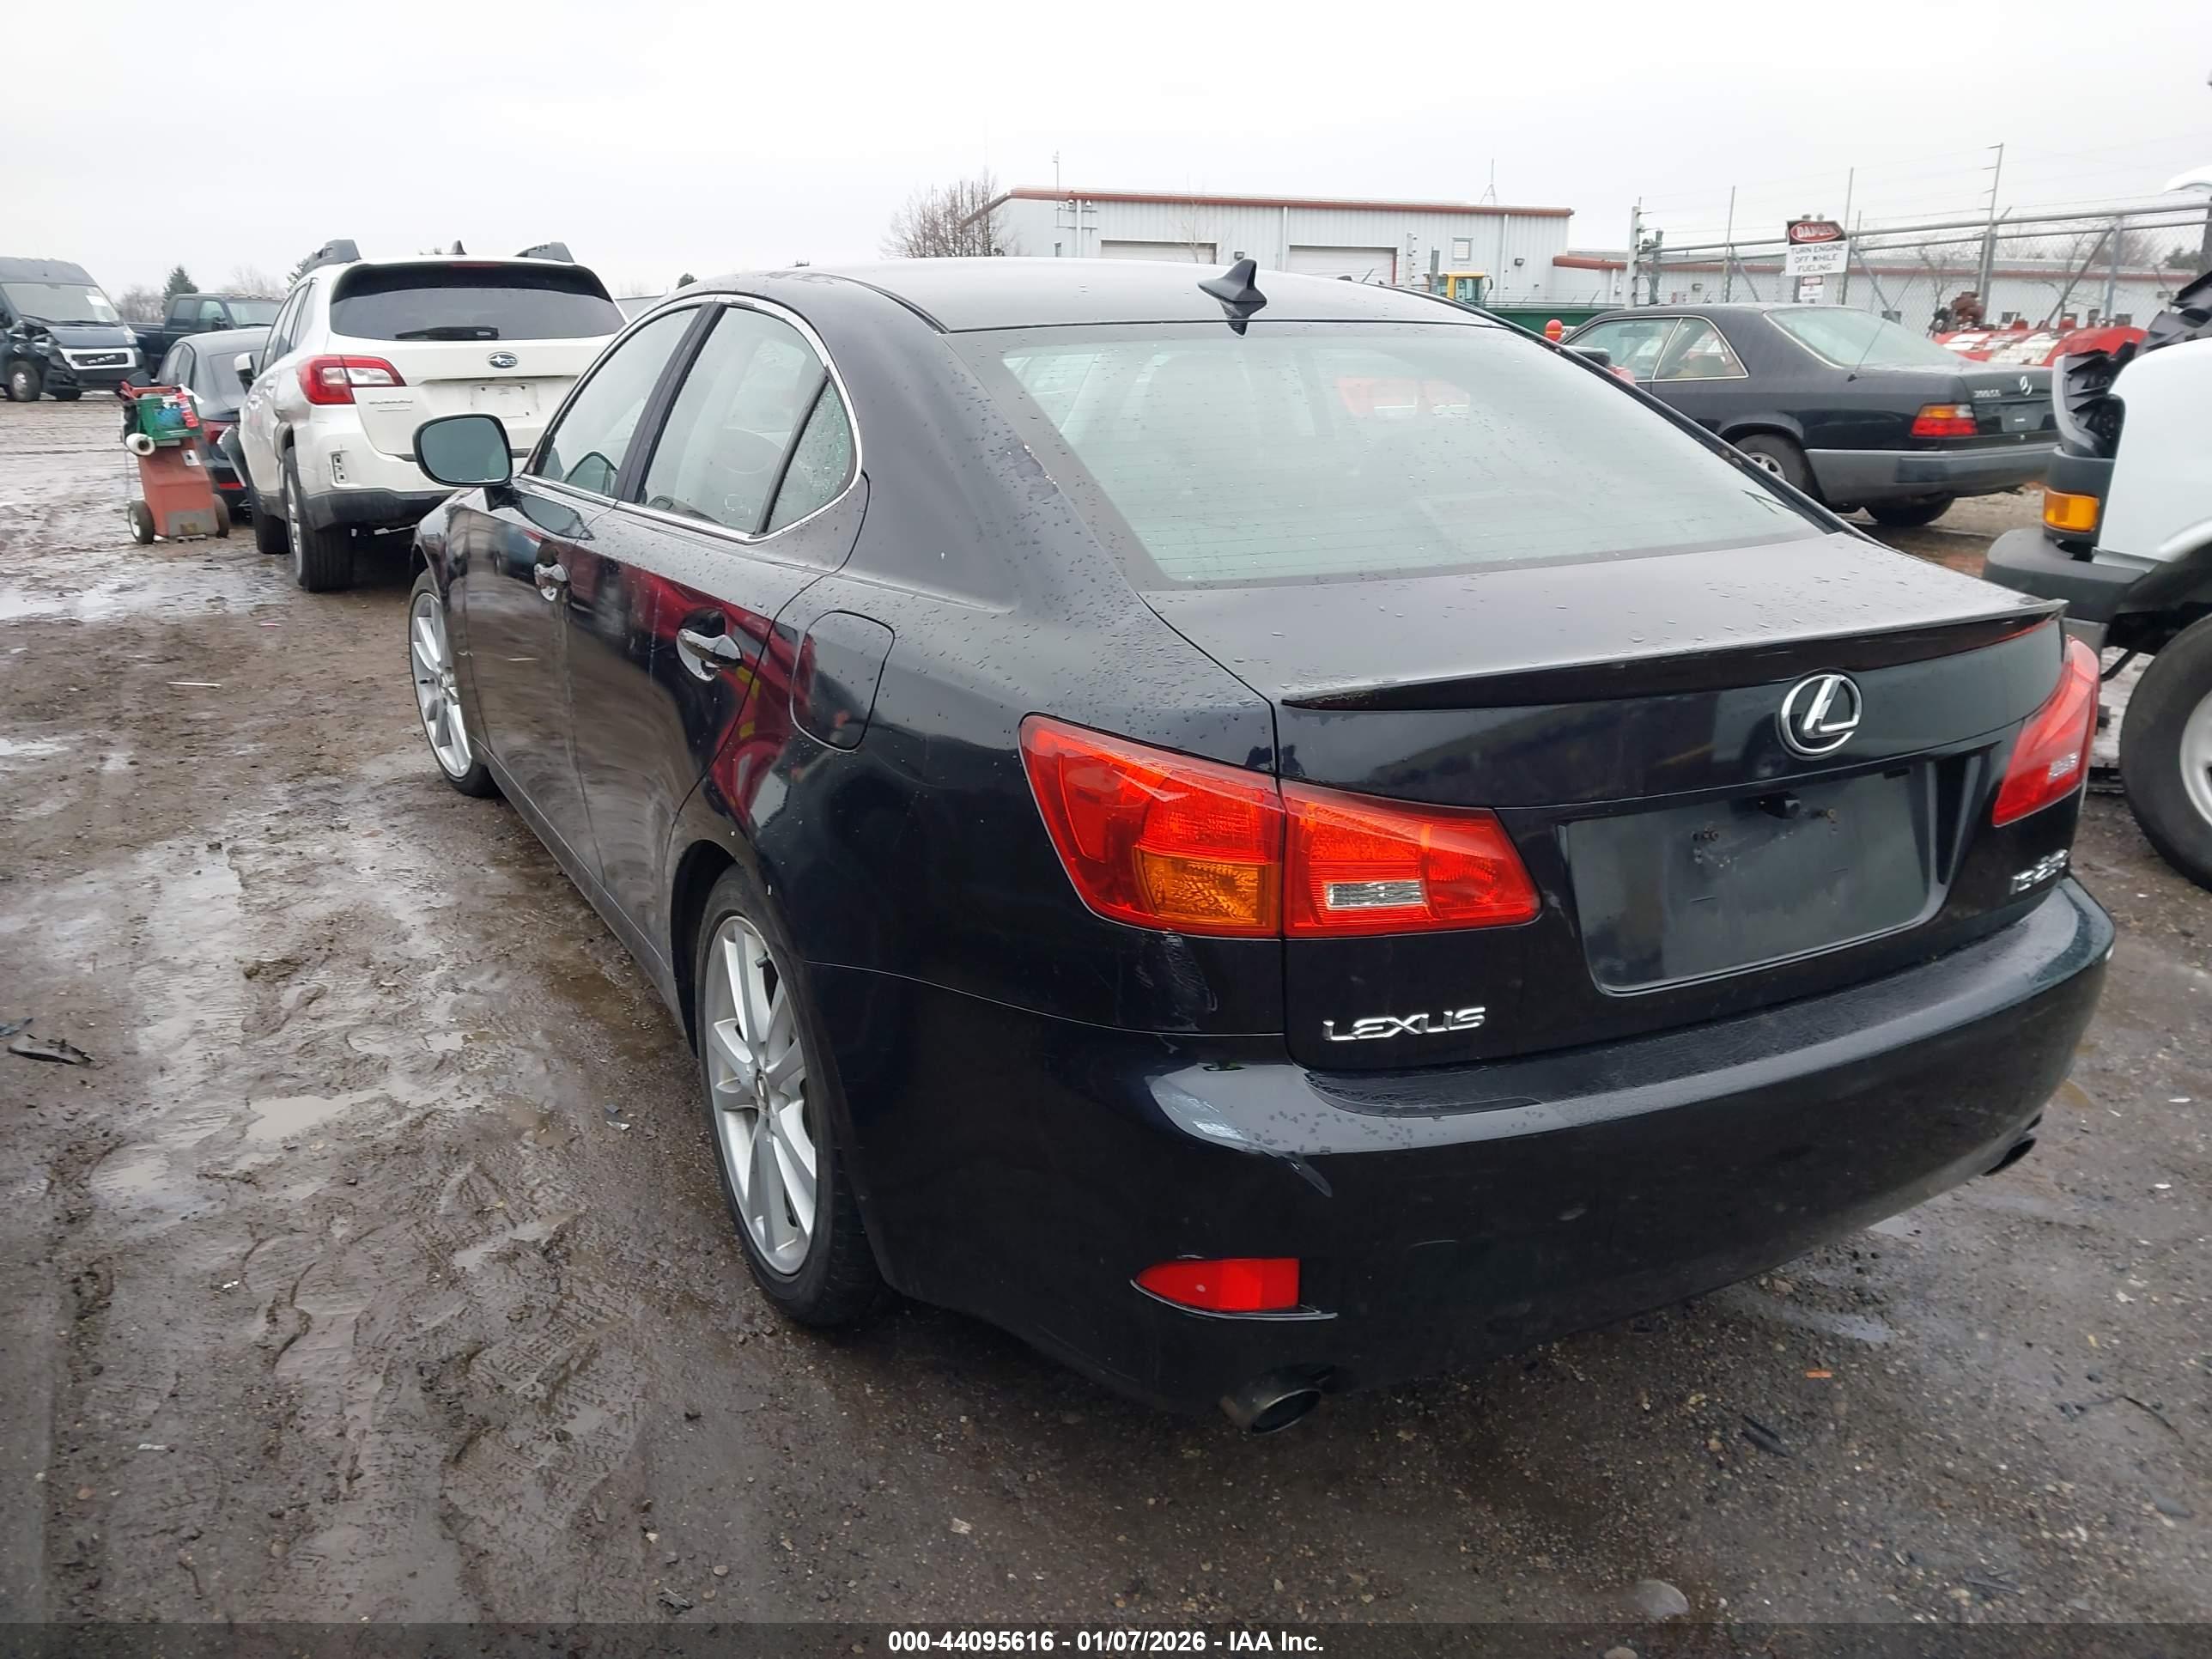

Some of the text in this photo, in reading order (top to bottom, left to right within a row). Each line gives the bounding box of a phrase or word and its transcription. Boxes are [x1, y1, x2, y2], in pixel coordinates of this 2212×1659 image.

[1790, 244, 1844, 255] TURN ENGINE
[1813, 253, 1838, 262] WHILE
[1796, 263, 1832, 272] FUELING
[1322, 1006, 1486, 1042] LEXUS
